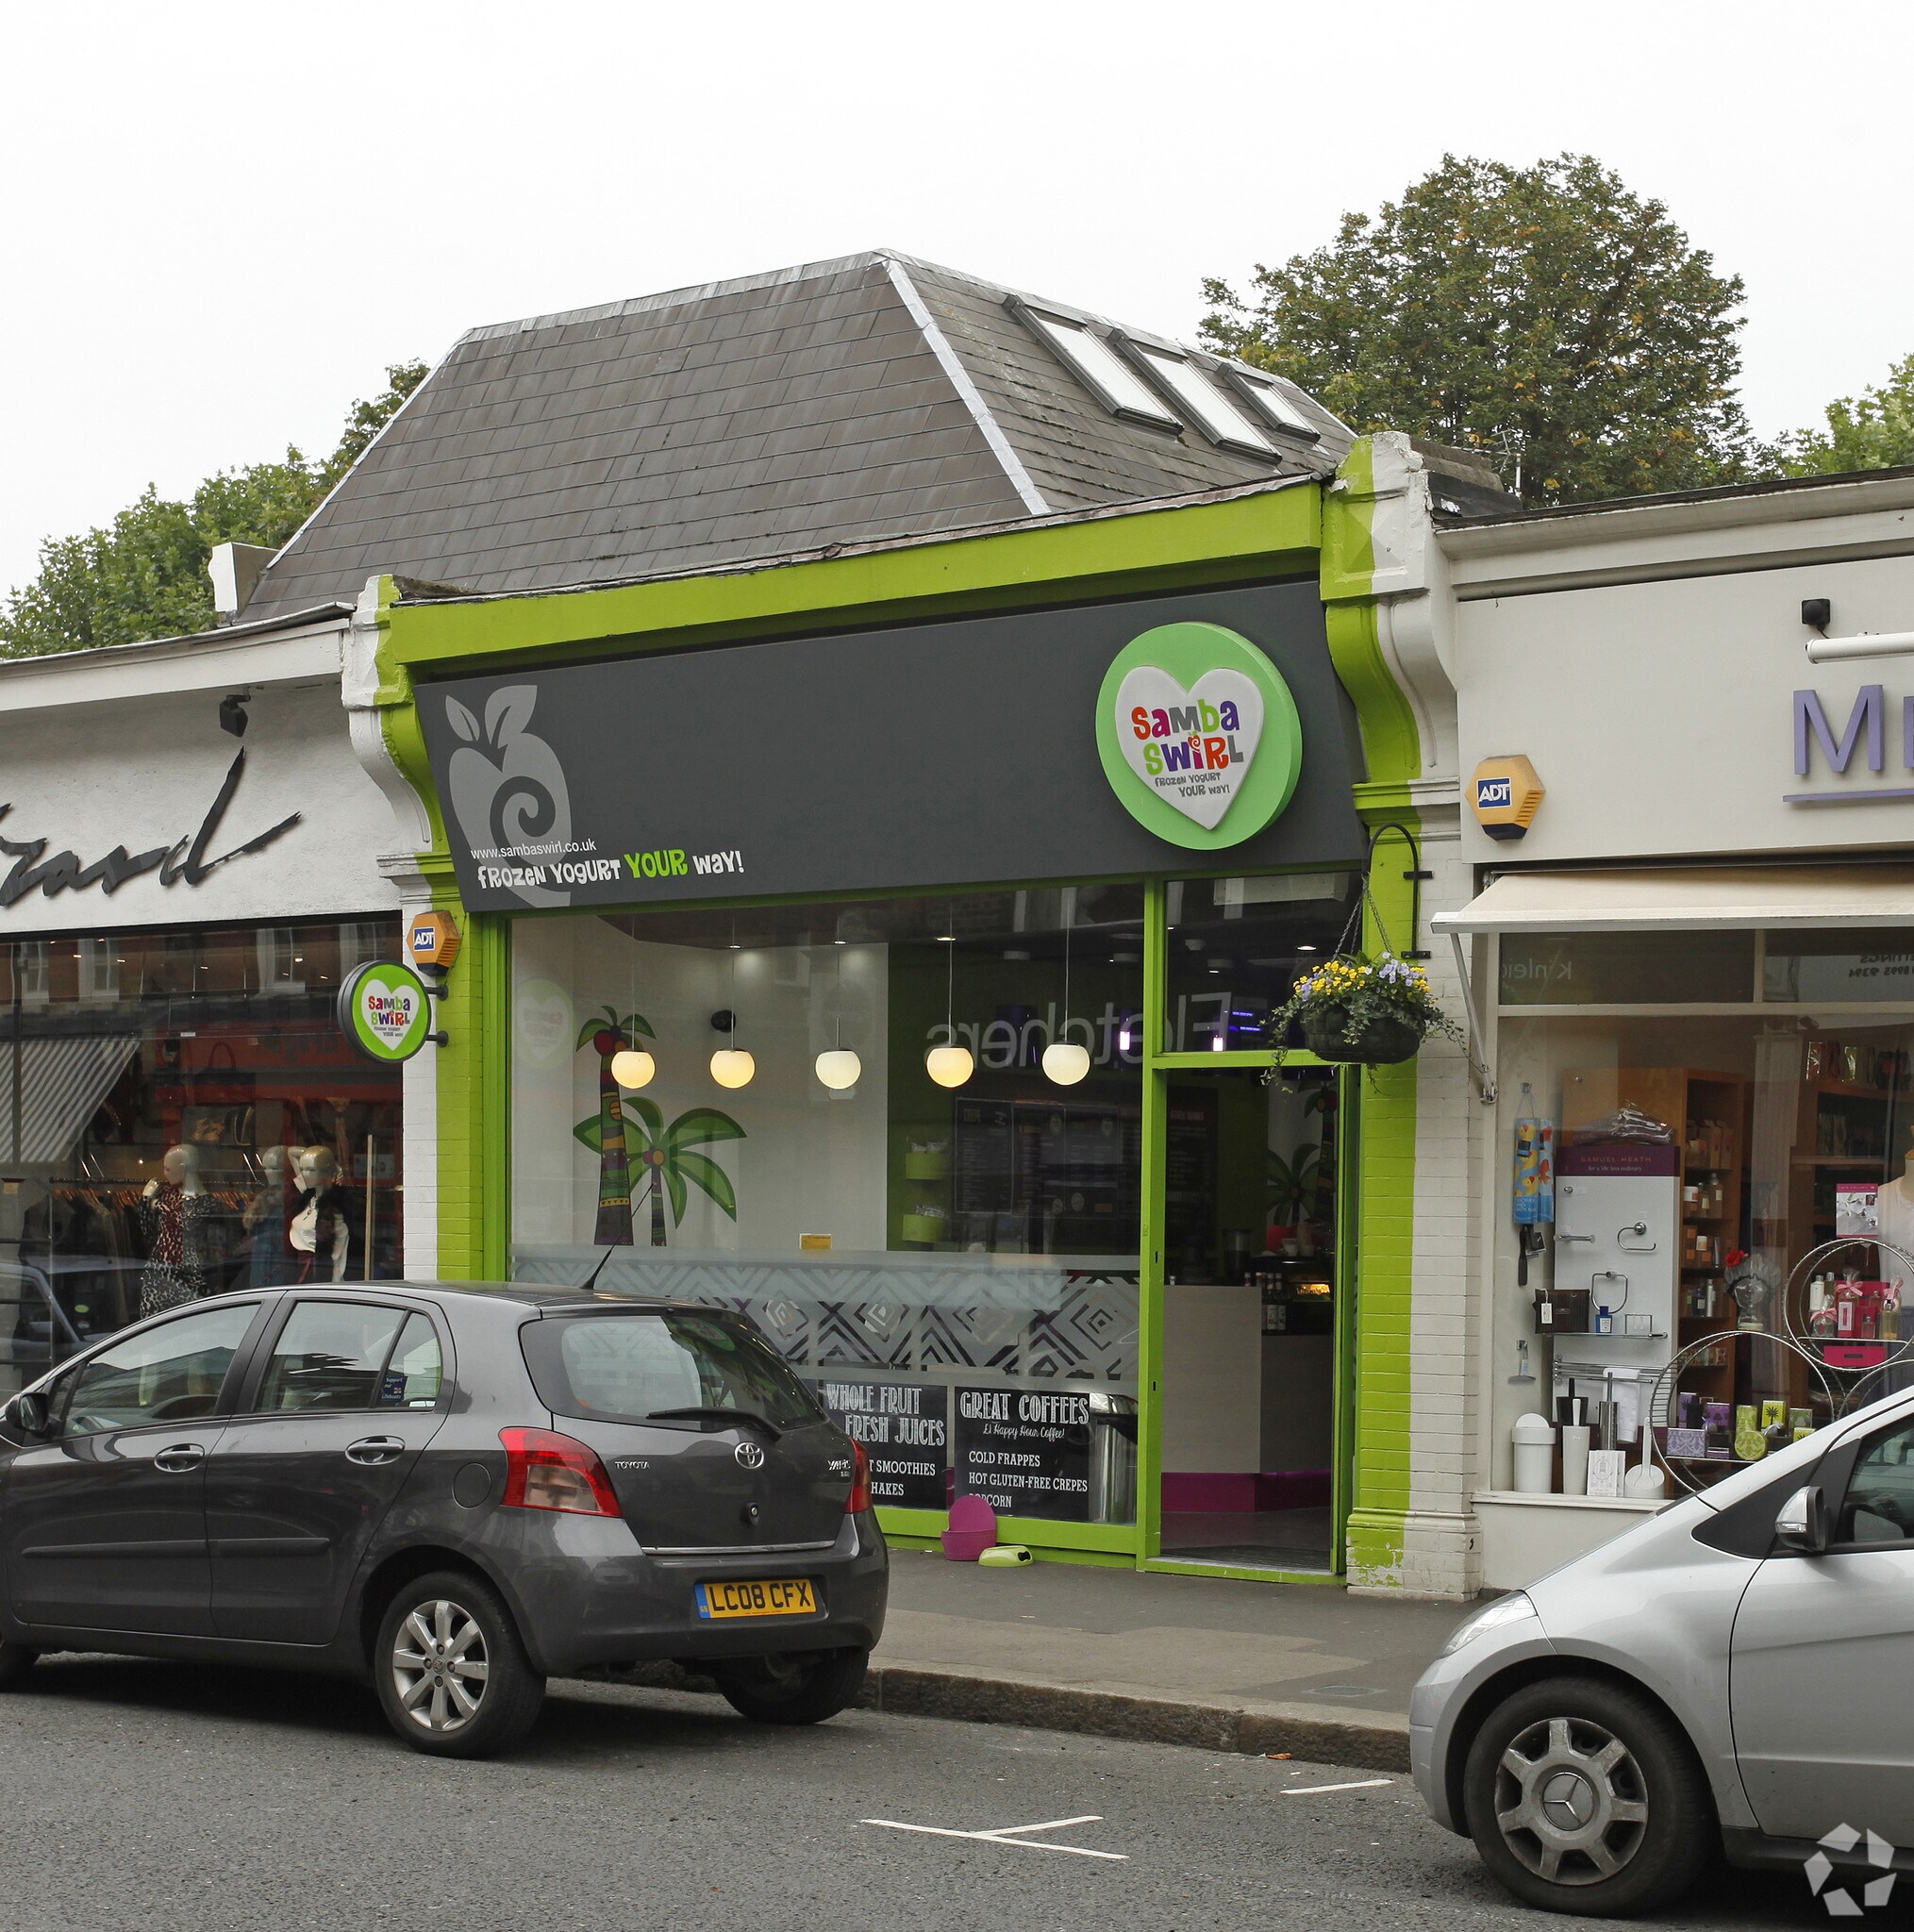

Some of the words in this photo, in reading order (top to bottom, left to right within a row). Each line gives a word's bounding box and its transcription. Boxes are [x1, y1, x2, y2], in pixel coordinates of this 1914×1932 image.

[1792, 684, 1914, 774] M
[1178, 785, 1206, 797] YOUR
[1478, 784, 1510, 802] ADT
[471, 838, 597, 859] www.sambaswirl.co.uk
[624, 848, 689, 878] YOUR
[413, 932, 434, 946] ADT
[826, 1384, 874, 1412] WHOLE
[880, 1386, 923, 1414] FRUIT
[959, 1391, 1011, 1421] GREAT
[1019, 1394, 1090, 1424] COFFEES
[845, 1414, 889, 1442] FRESH
[894, 1417, 945, 1446] JUICES
[993, 1424, 1018, 1440] Happy
[1019, 1425, 1039, 1437] Hour
[1040, 1426, 1065, 1442] Coffee!
[614, 1461, 651, 1470] TOYOTA
[876, 1459, 936, 1476] SMOOTHIES
[969, 1451, 996, 1464] COLD
[997, 1453, 1040, 1468] FRAPPES
[969, 1472, 988, 1485] HOT
[990, 1473, 1052, 1490] GLUTEN-FREE
[1053, 1477, 1088, 1492] CREPES
[709, 1584, 766, 1612] LC08
[769, 1582, 811, 1608] CFX
